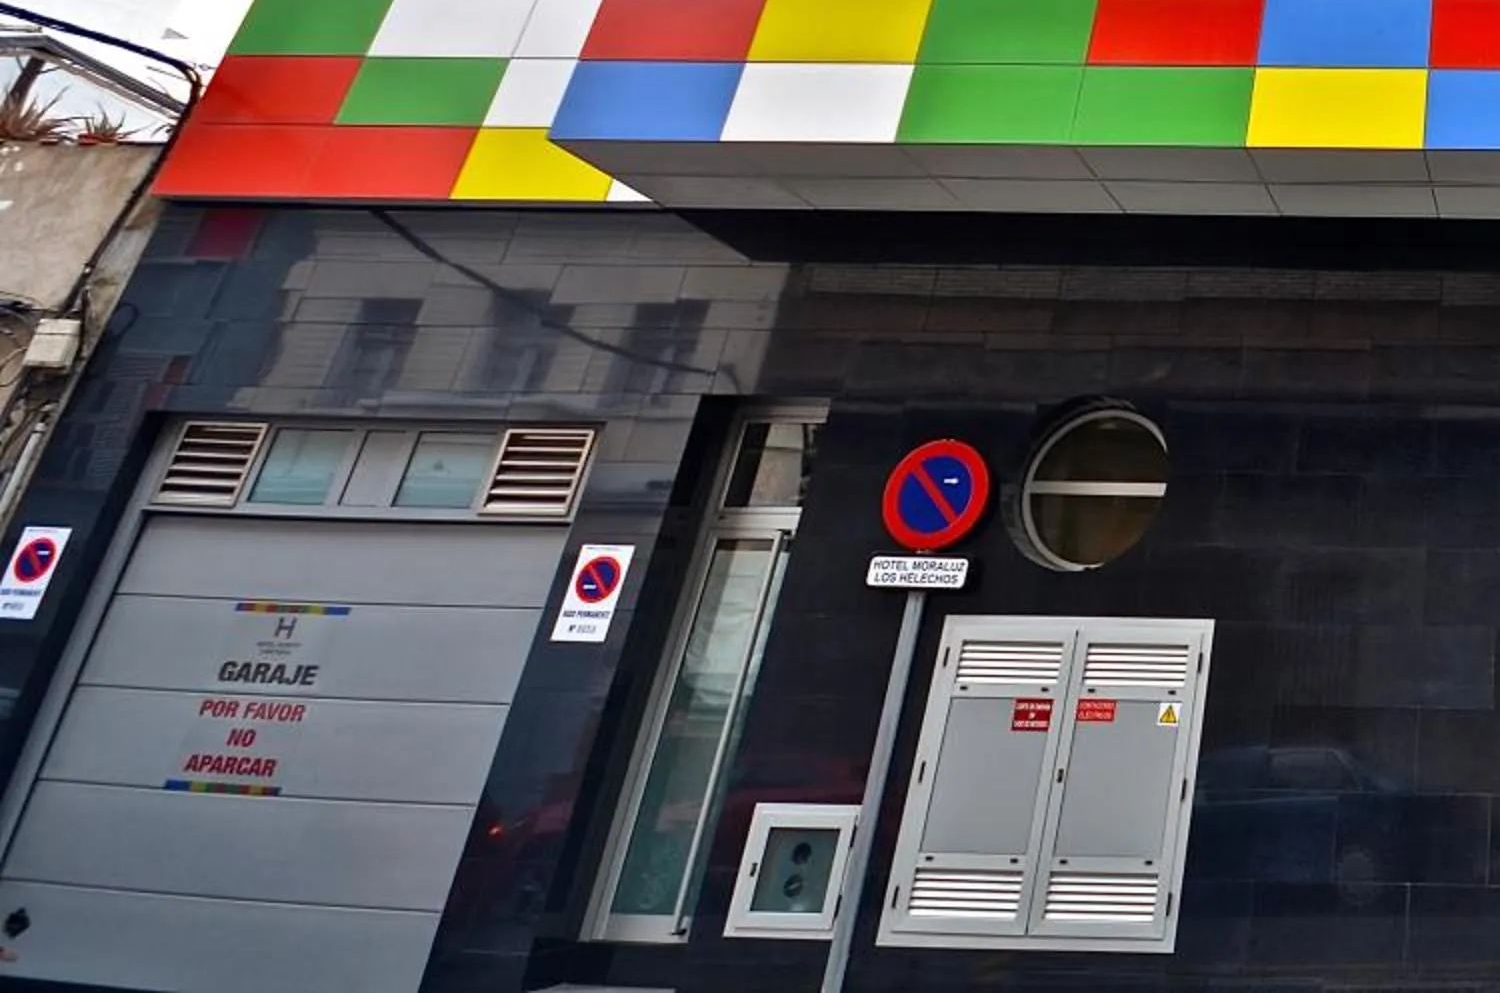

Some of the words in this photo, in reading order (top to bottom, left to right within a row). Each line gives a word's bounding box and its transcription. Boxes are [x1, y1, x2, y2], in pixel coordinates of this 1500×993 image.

[873, 560, 909, 571] HOTEL
[873, 572, 897, 583] LOS
[274, 615, 298, 640] H
[217, 660, 320, 686] GARAJE
[199, 699, 240, 718] POR
[243, 701, 306, 722] FAVOR
[226, 727, 257, 747] NO
[184, 754, 278, 777] APARCAR
